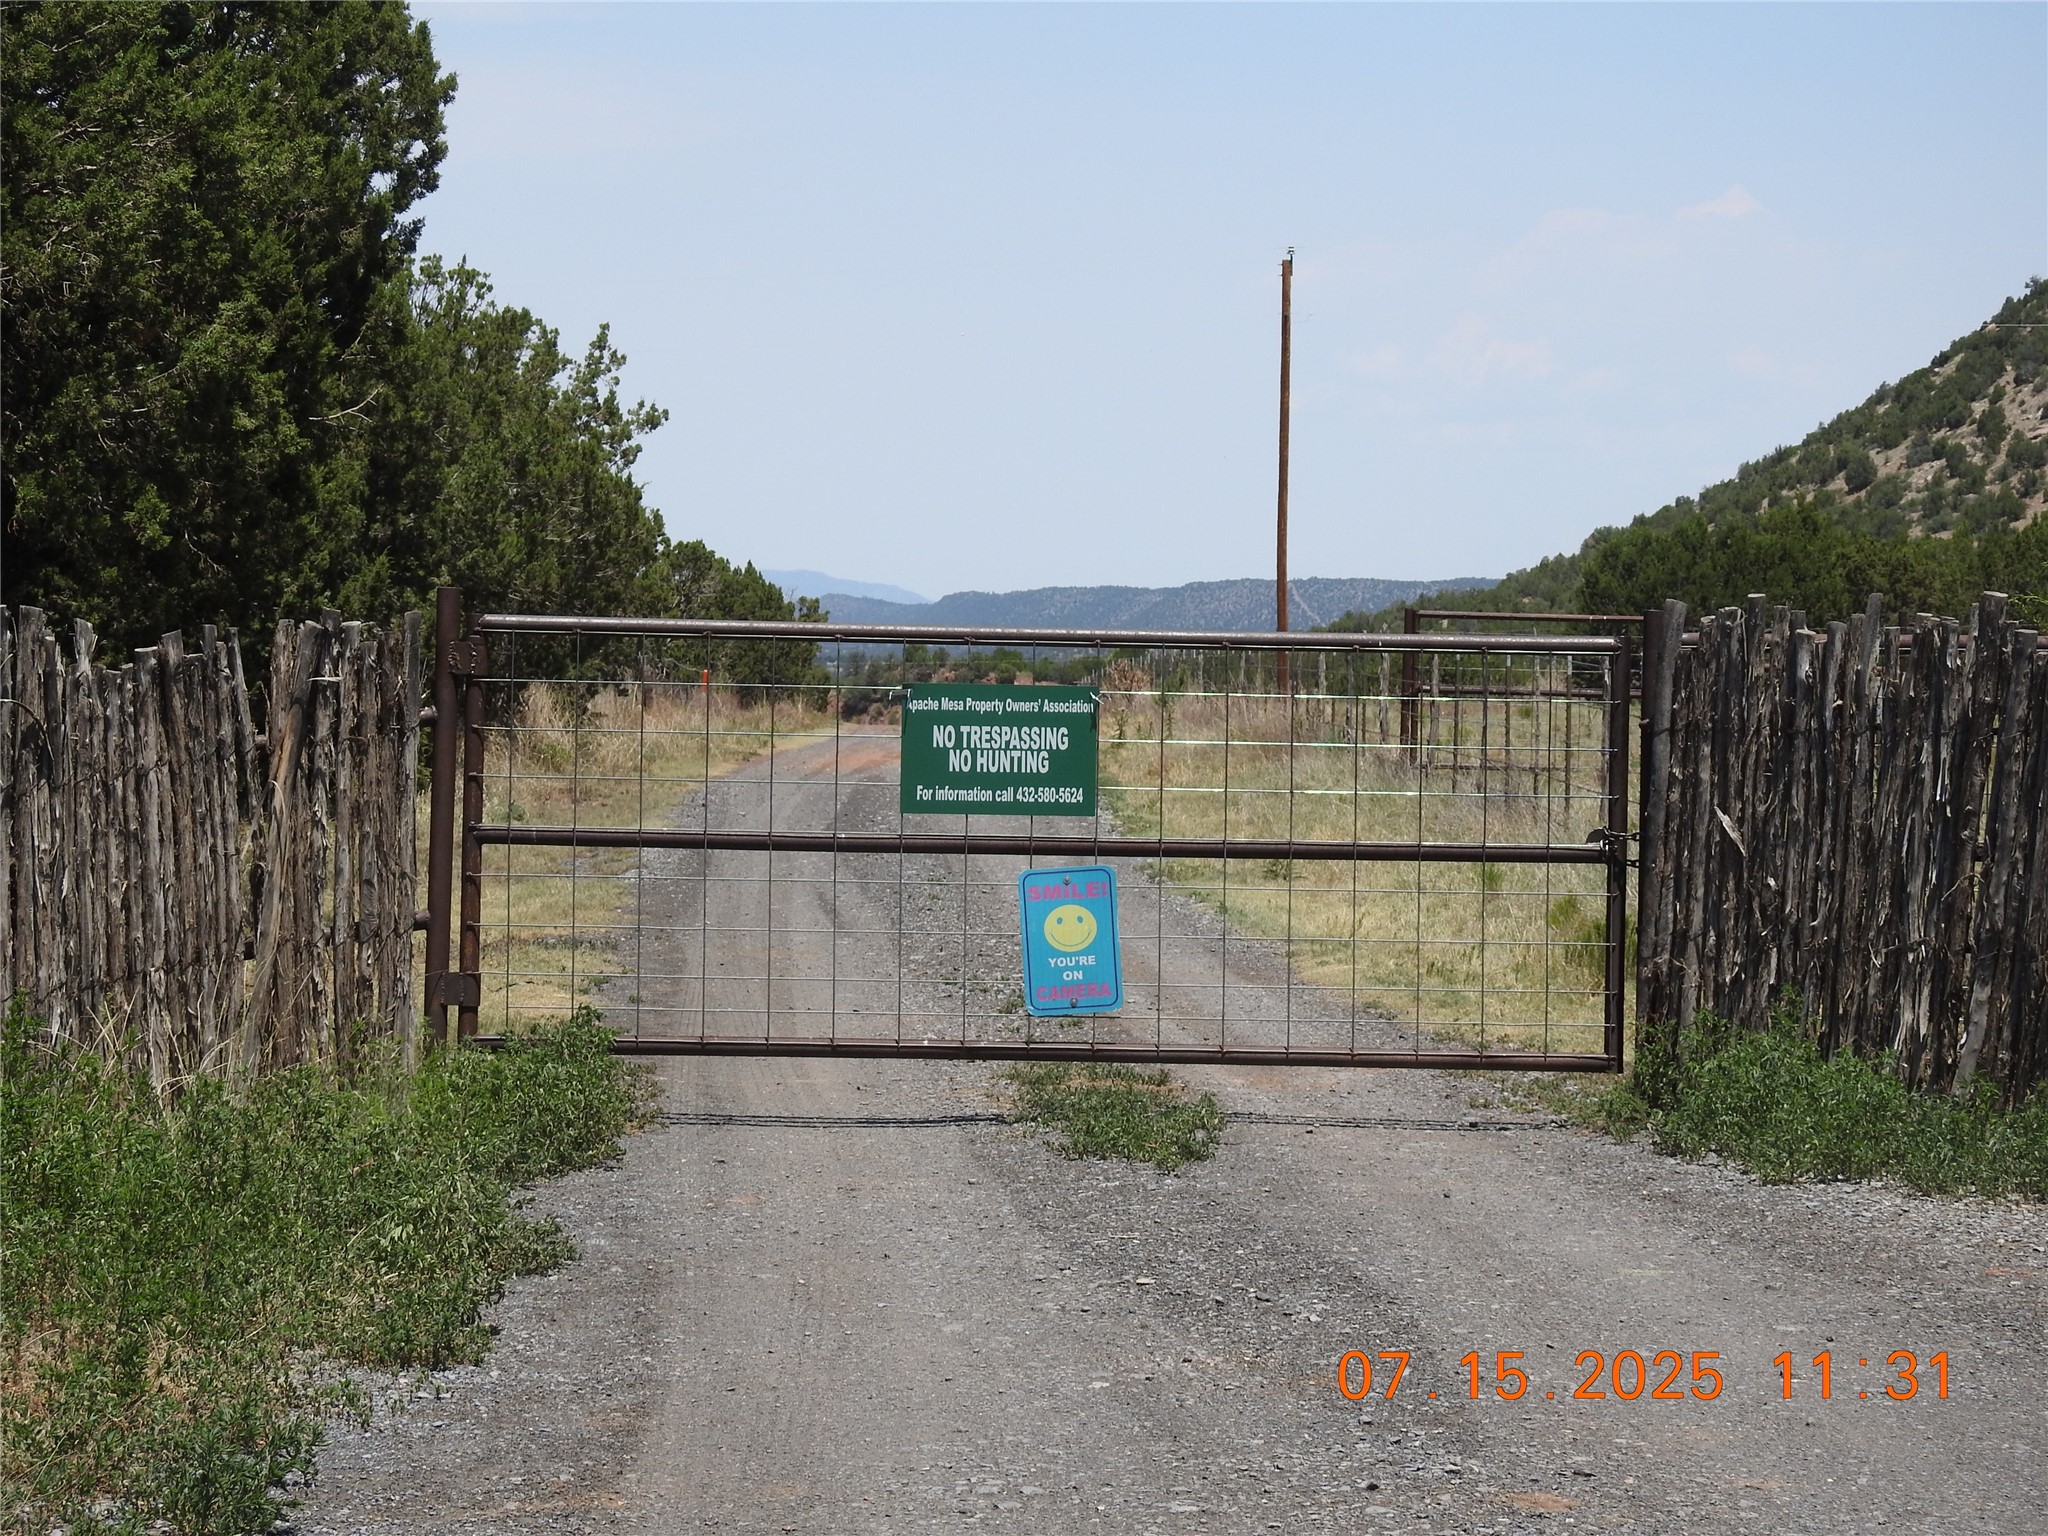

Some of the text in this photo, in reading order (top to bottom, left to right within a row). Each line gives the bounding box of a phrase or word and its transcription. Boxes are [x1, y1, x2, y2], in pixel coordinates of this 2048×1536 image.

[907, 696, 1094, 715] Apache Mesa Property Owners' Association
[932, 725, 1069, 750] NO TRESPASSING
[949, 749, 1049, 774] NO HUNTING
[916, 785, 1084, 803] For information call 432-580-5624
[1028, 882, 1107, 901] SMILE!
[1048, 955, 1096, 968] YOU'RE
[1062, 970, 1083, 981] ON
[1037, 983, 1112, 1001] CAMERA
